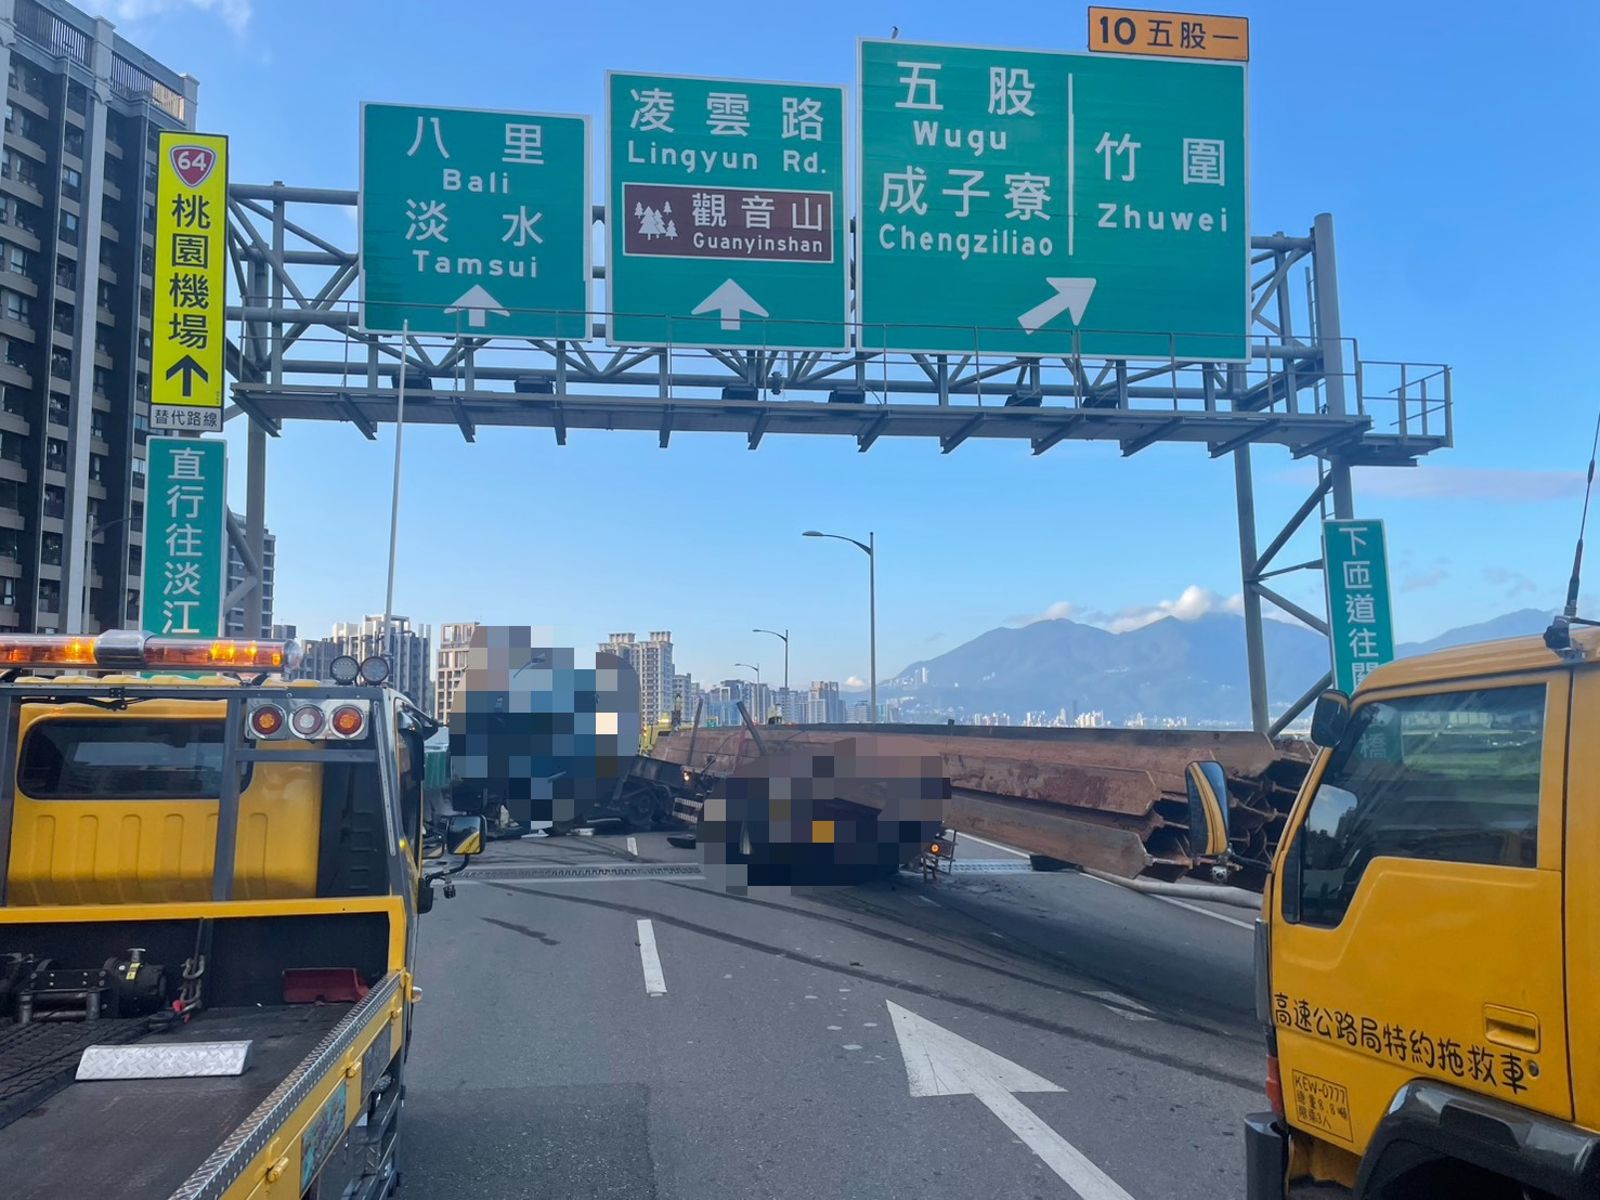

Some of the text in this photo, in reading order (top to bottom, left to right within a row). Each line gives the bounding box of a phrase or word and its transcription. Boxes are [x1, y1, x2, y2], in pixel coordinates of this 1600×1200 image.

[1100, 16, 1240, 51] 10 五股一
[895, 61, 1036, 118] 五股
[629, 87, 824, 142] 凌雲路
[406, 115, 545, 165] 八里
[913, 120, 1007, 157] Wugu
[178, 150, 207, 171] 64
[628, 140, 827, 175] Lingyun Rd.
[1095, 132, 1225, 187] 竹圍
[442, 168, 509, 194] Bali
[879, 165, 1052, 222] 成子寮
[405, 197, 544, 248] 淡水
[691, 192, 823, 232] 觀音山
[1097, 202, 1228, 234] Zhuwei
[693, 232, 823, 254] Guanyinshan
[879, 224, 1053, 261] Chengziliao
[168, 193, 211, 350] 桃園機場
[412, 249, 538, 279] Tamsui
[153, 408, 218, 428] 替代路線
[162, 446, 206, 635] 直行往淡江
[1274, 991, 1528, 1095] 高速公路局特約拖救車
[1295, 1074, 1345, 1105] KEW-0777
